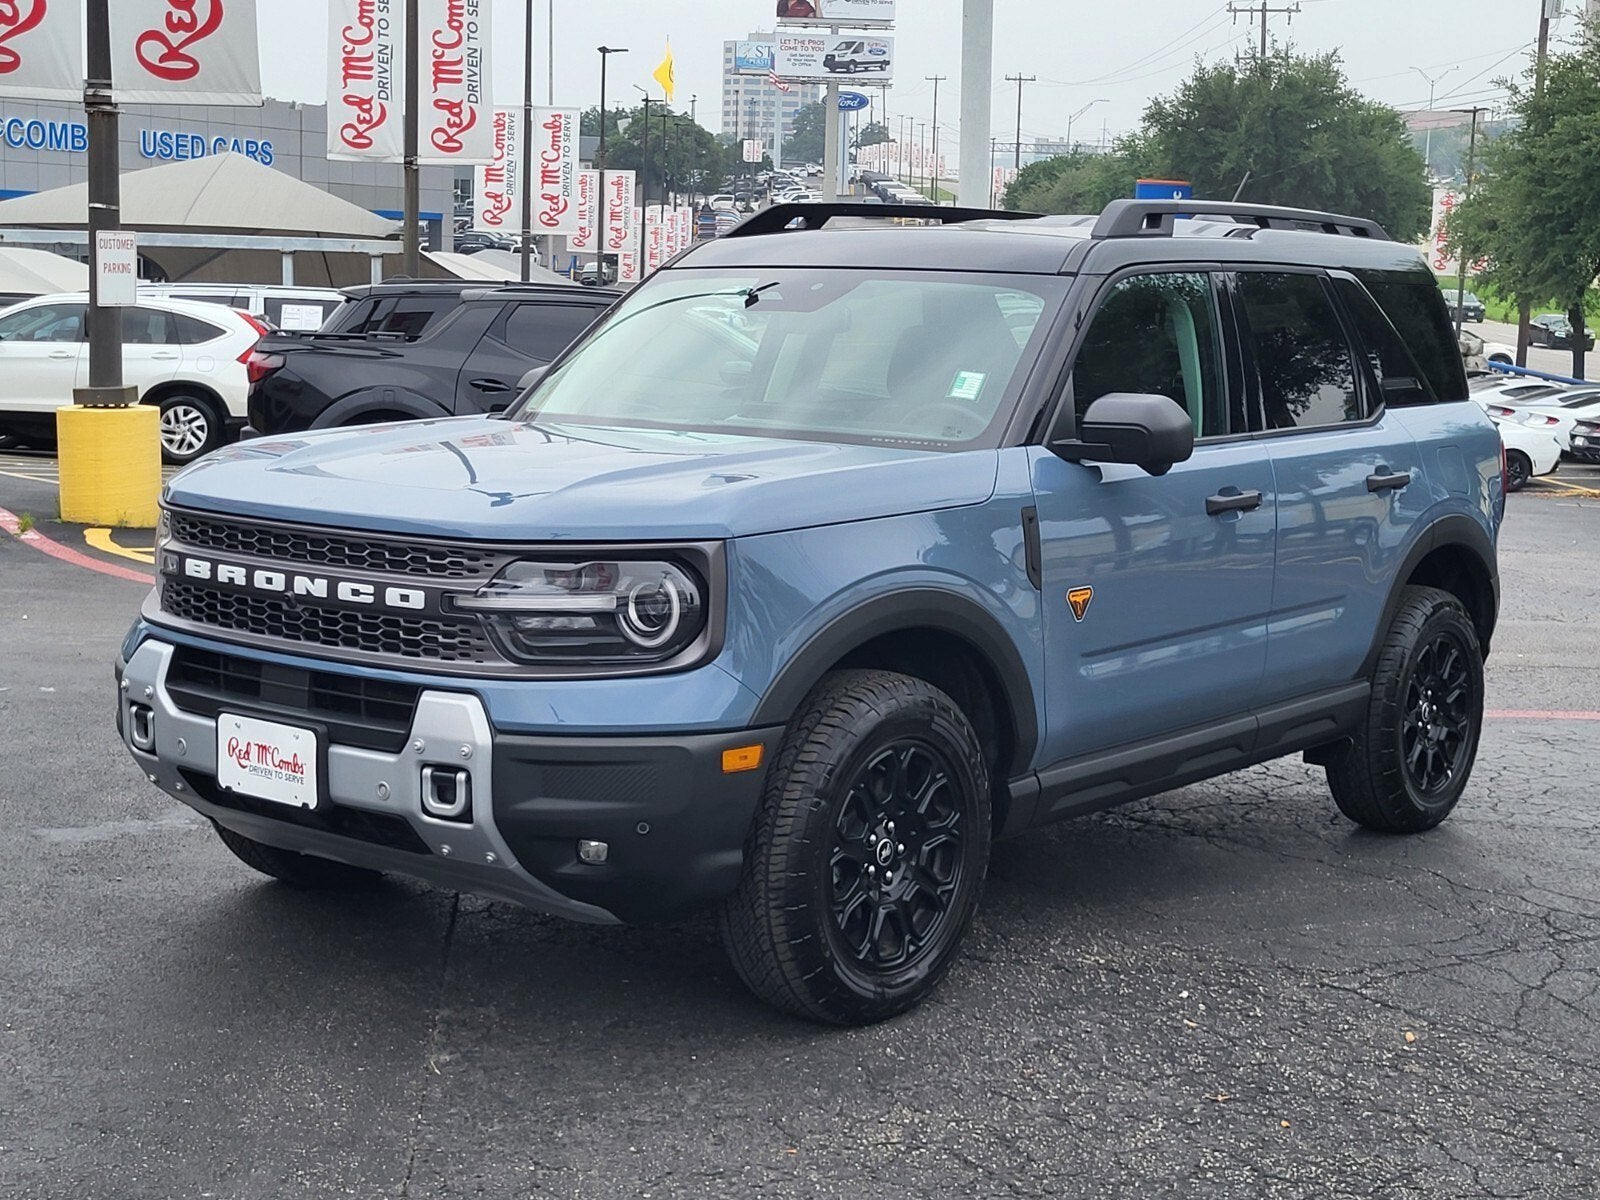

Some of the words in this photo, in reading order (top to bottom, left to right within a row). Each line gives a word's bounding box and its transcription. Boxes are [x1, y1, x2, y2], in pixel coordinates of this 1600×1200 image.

[136, 0, 224, 81] Re
[342, 0, 375, 89] McCom
[378, 19, 390, 38] TO
[467, 22, 478, 42] TO
[432, 0, 464, 93] McCom
[377, 44, 391, 101] DRIVEN
[467, 47, 480, 104] DRIVEN
[341, 94, 386, 149] Red
[431, 98, 476, 153] Red
[507, 112, 516, 142] SERVE
[563, 114, 572, 143] SERVE
[0, 118, 89, 152] COMB
[141, 130, 205, 160] USED
[213, 137, 274, 167] CARS
[507, 144, 514, 157] TO
[540, 113, 562, 190] McCombs
[562, 145, 570, 158] TO
[506, 161, 516, 196] DRIVEN
[562, 163, 572, 198] DRIVEN
[482, 192, 511, 225] Red
[539, 193, 568, 227] Red
[588, 194, 594, 204] TO
[609, 175, 624, 225] McCombs
[624, 194, 630, 204] TO
[99, 238, 134, 250] CUSTOMER
[608, 226, 628, 249] Red
[103, 262, 132, 274] PARKING
[622, 262, 636, 279] Red
[185, 558, 425, 610] BRONCO
[228, 736, 251, 770] Red
[254, 743, 304, 776] McCombs
[248, 764, 273, 778] DRIVEN
[274, 770, 283, 780] TO
[284, 772, 304, 786] SERVE
